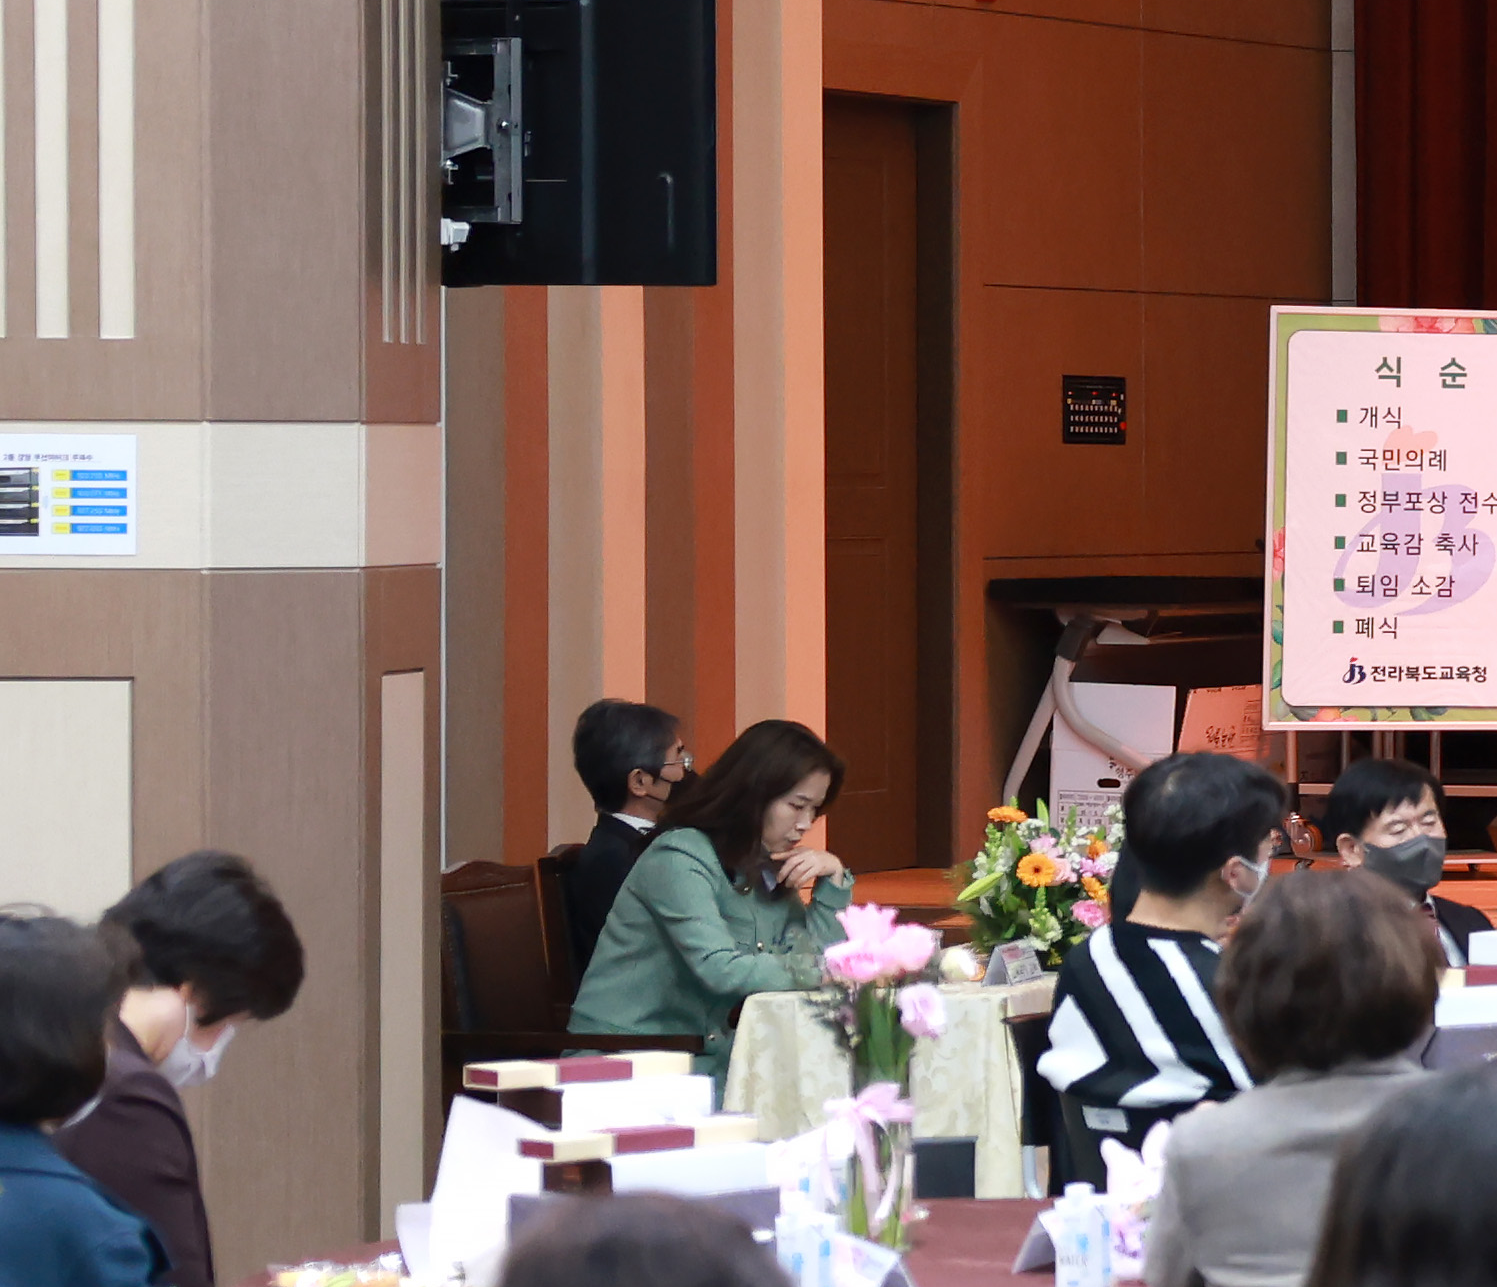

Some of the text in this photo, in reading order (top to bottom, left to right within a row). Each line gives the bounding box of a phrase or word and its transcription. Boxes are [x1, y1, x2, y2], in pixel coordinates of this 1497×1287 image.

[1358, 406, 1402, 429] 개식
[1358, 448, 1448, 472] 국민의례
[1357, 490, 1448, 514] 정부포상
[1356, 533, 1479, 556] 교육감 축사
[1355, 574, 1455, 598] 퇴임 소감
[1354, 616, 1398, 639] 폐식
[1370, 665, 1488, 683] 전라북도교육청
